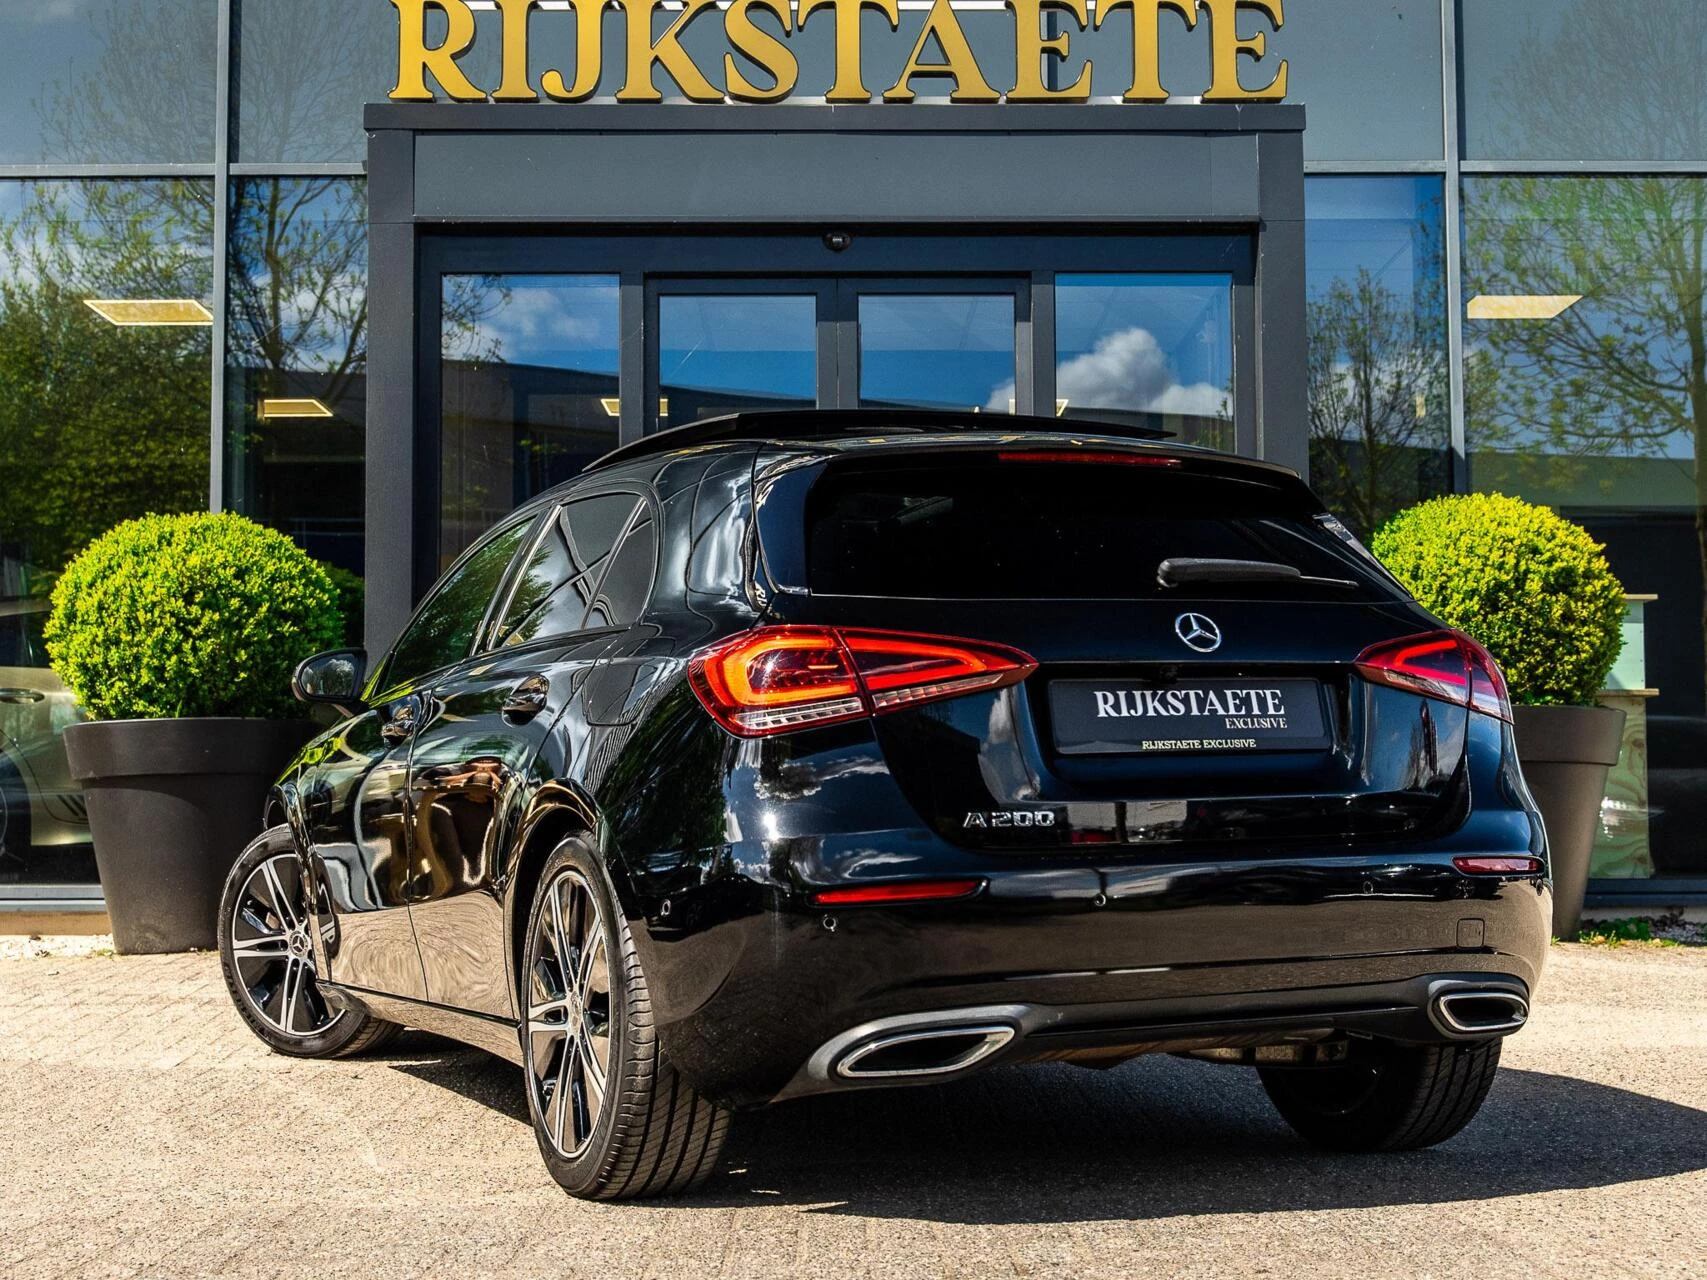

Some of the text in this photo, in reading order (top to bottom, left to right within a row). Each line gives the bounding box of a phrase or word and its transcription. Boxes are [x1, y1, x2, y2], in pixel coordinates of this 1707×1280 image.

[387, 0, 1289, 103] RIJKSTAETE
[1094, 689, 1285, 717] RIJKSTAETE
[1225, 717, 1287, 729] EXCLUSIVE
[1142, 738, 1257, 750] RIJKSTAETE EXCLUSIVE
[962, 811, 1055, 828] A 200
